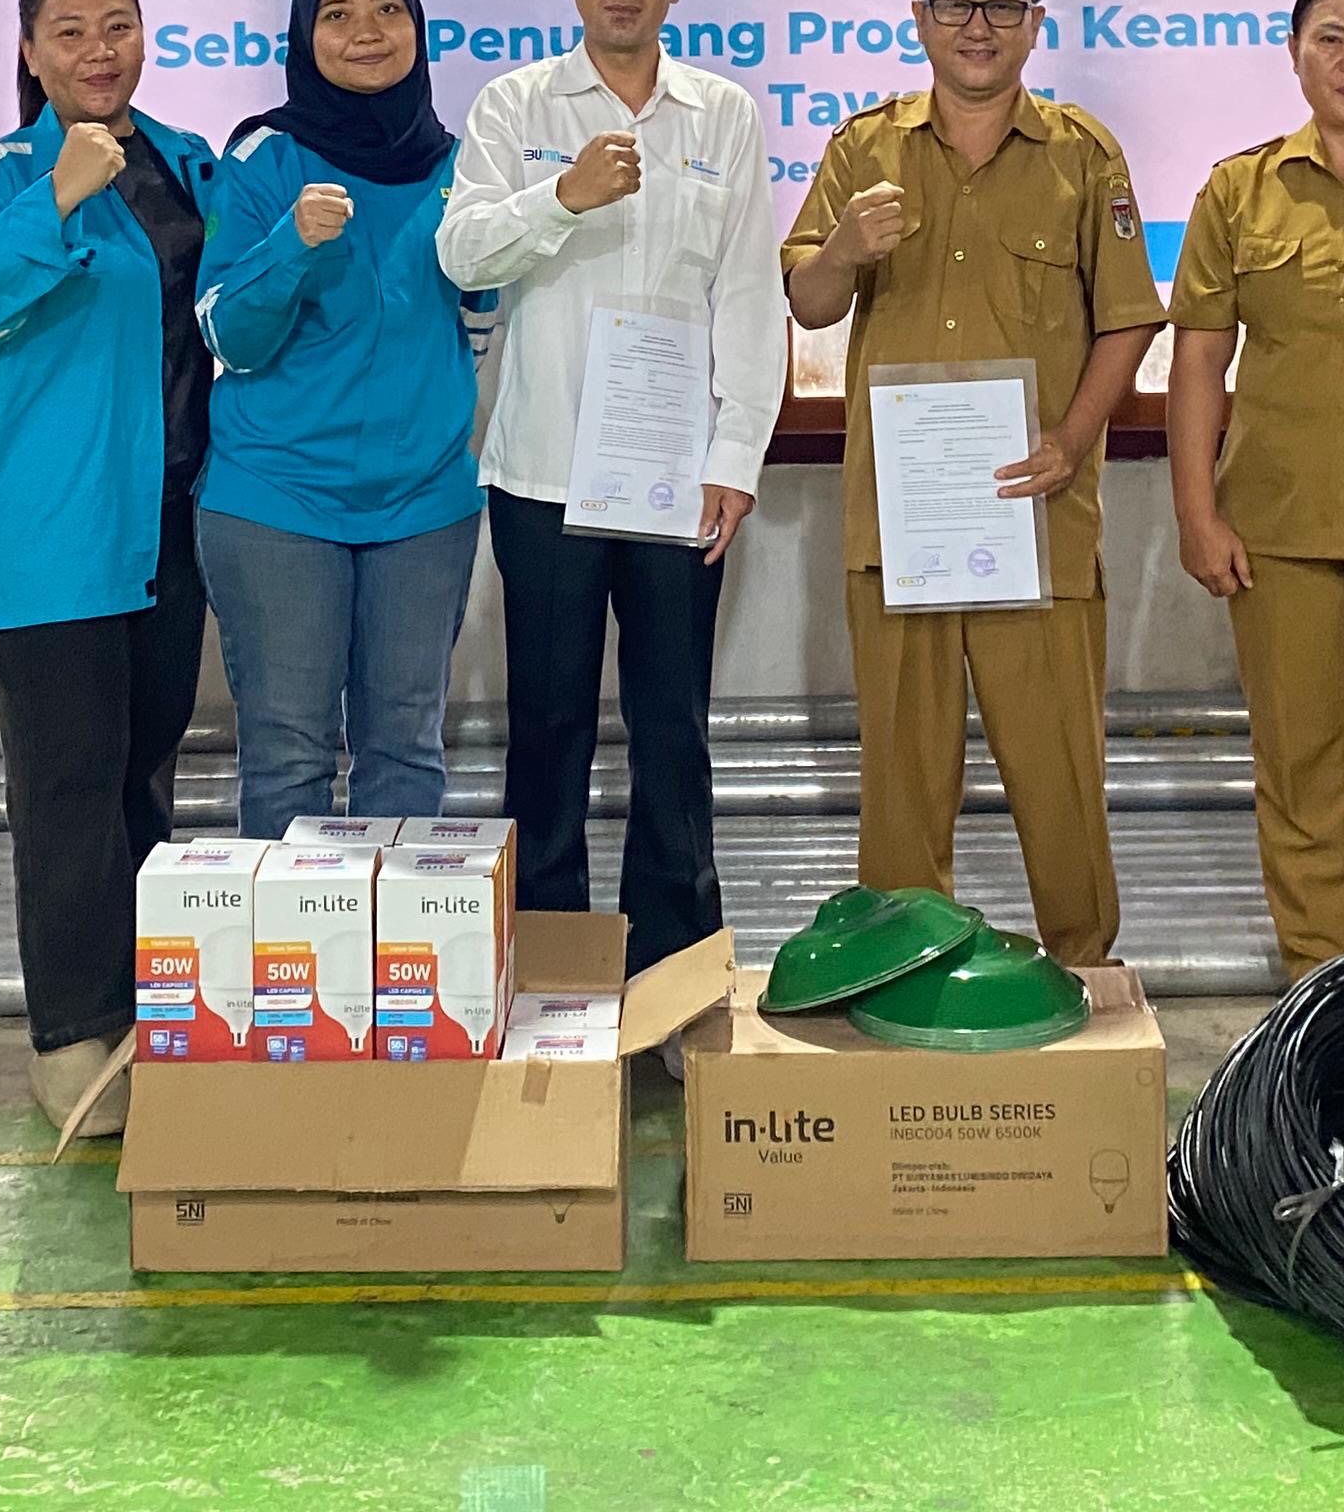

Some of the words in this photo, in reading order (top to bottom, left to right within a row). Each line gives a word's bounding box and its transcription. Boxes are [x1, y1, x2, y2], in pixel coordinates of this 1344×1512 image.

[427, 19, 765, 68] Penuang
[150, 957, 194, 976] 50W
[267, 962, 311, 981] 50W
[388, 962, 432, 981] 50W
[889, 1105, 925, 1122] LED
[932, 1105, 983, 1122] BULB
[989, 1103, 1056, 1121] SERIES
[958, 1126, 991, 1140] 50W
[995, 1126, 1042, 1139] 6500K
[758, 1149, 803, 1164] Value
[176, 1201, 205, 1219] SNI
[724, 1195, 752, 1213] SNI
